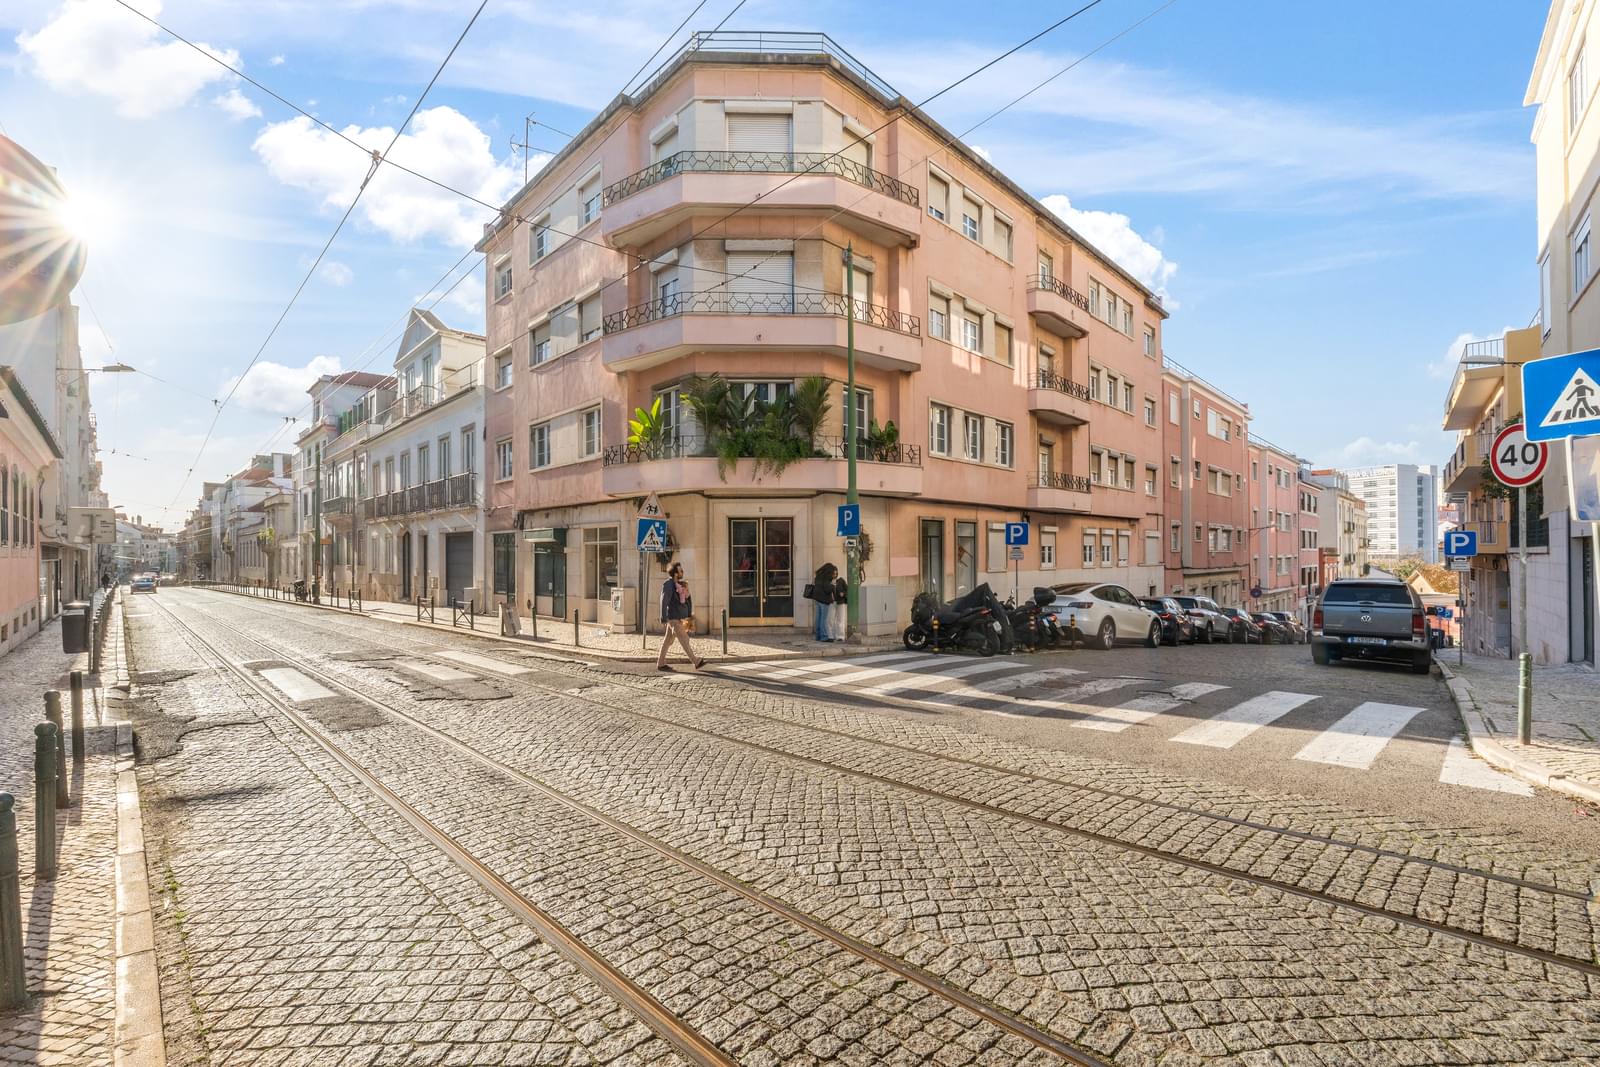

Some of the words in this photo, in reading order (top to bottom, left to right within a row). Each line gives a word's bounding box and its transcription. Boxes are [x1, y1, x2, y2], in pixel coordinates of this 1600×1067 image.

[1500, 443, 1539, 466] 40
[844, 510, 853, 527] P
[1010, 525, 1024, 543] P
[1450, 533, 1470, 554] P
